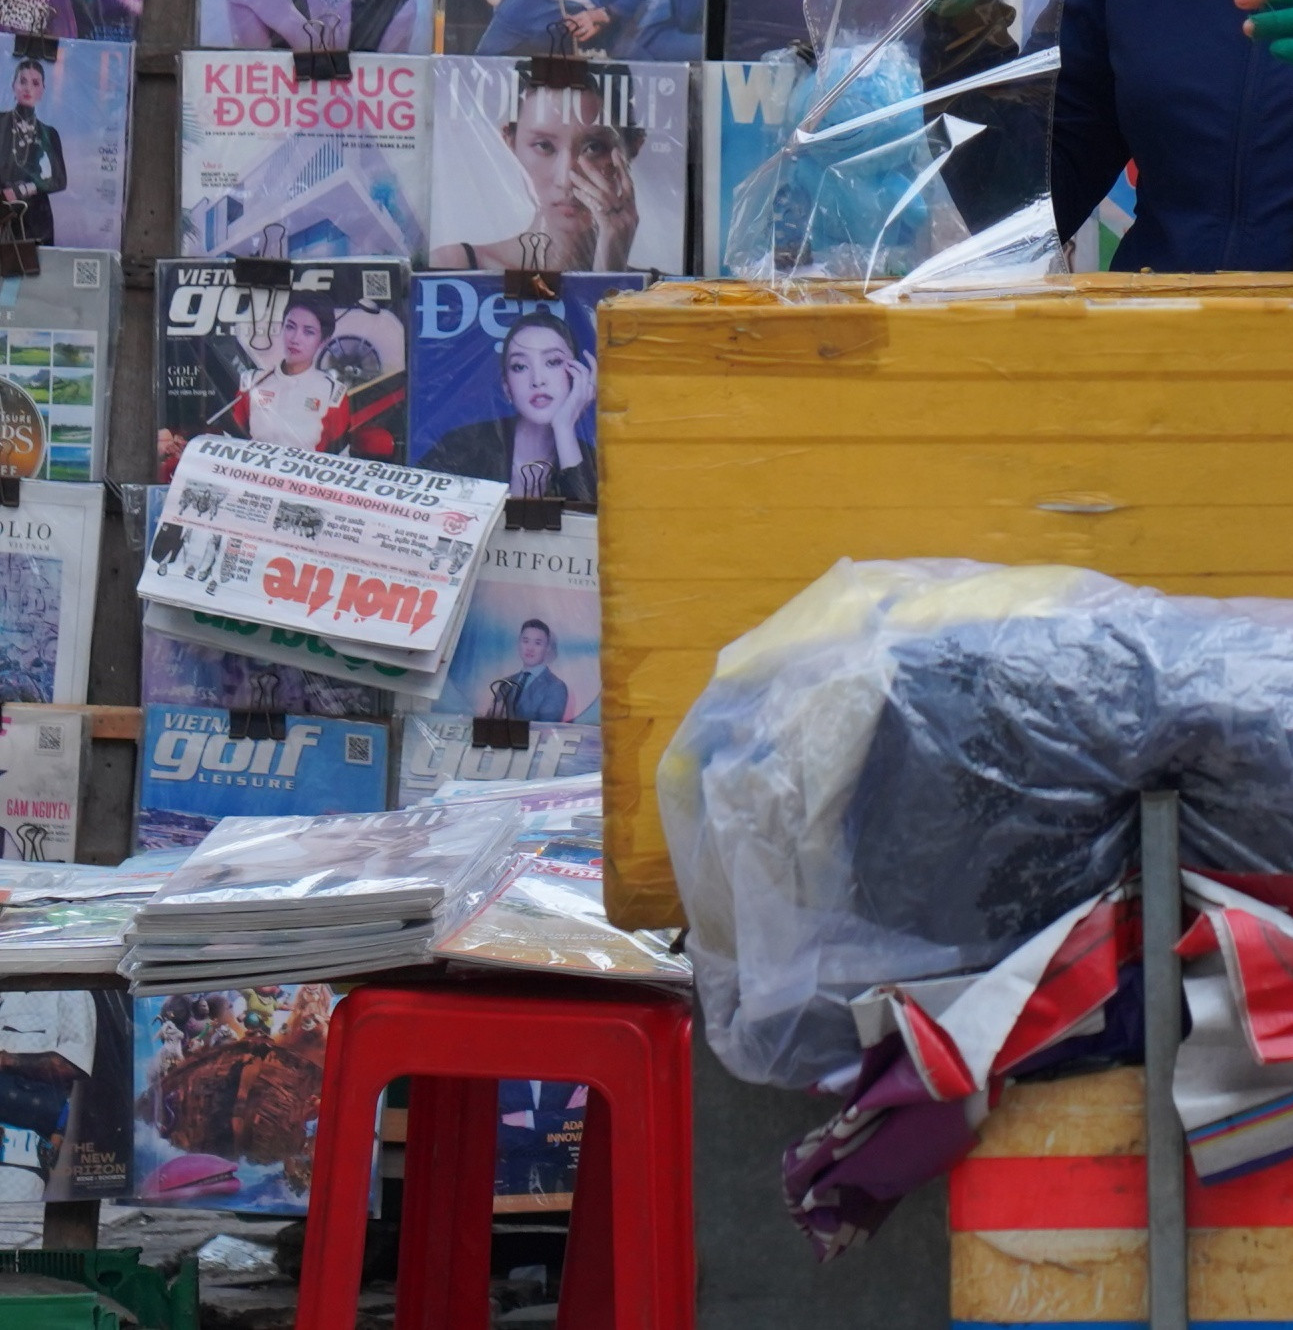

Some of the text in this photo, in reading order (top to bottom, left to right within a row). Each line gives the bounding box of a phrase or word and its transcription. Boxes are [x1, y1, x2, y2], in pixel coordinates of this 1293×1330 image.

[177, 268, 237, 286] VIETN
[199, 441, 440, 507] GIAO THÔNG XANH
[211, 464, 229, 475] XE
[365, 462, 424, 490] cũng
[424, 476, 452, 492] ai
[309, 486, 345, 502] TIẾNG
[346, 495, 389, 512] KHÔNG
[389, 504, 410, 518] THỊ
[412, 511, 430, 522] ĐÔ
[568, 577, 598, 587] VIETN
[262, 556, 439, 636] tuổi trẻ
[164, 713, 230, 733] VIETN
[150, 724, 322, 782] golf
[198, 772, 296, 791] LEISURE
[562, 1120, 584, 1131] ADA
[73, 1142, 95, 1152] HE
[80, 1152, 116, 1164] NEW
[72, 1163, 126, 1176] RIZON
